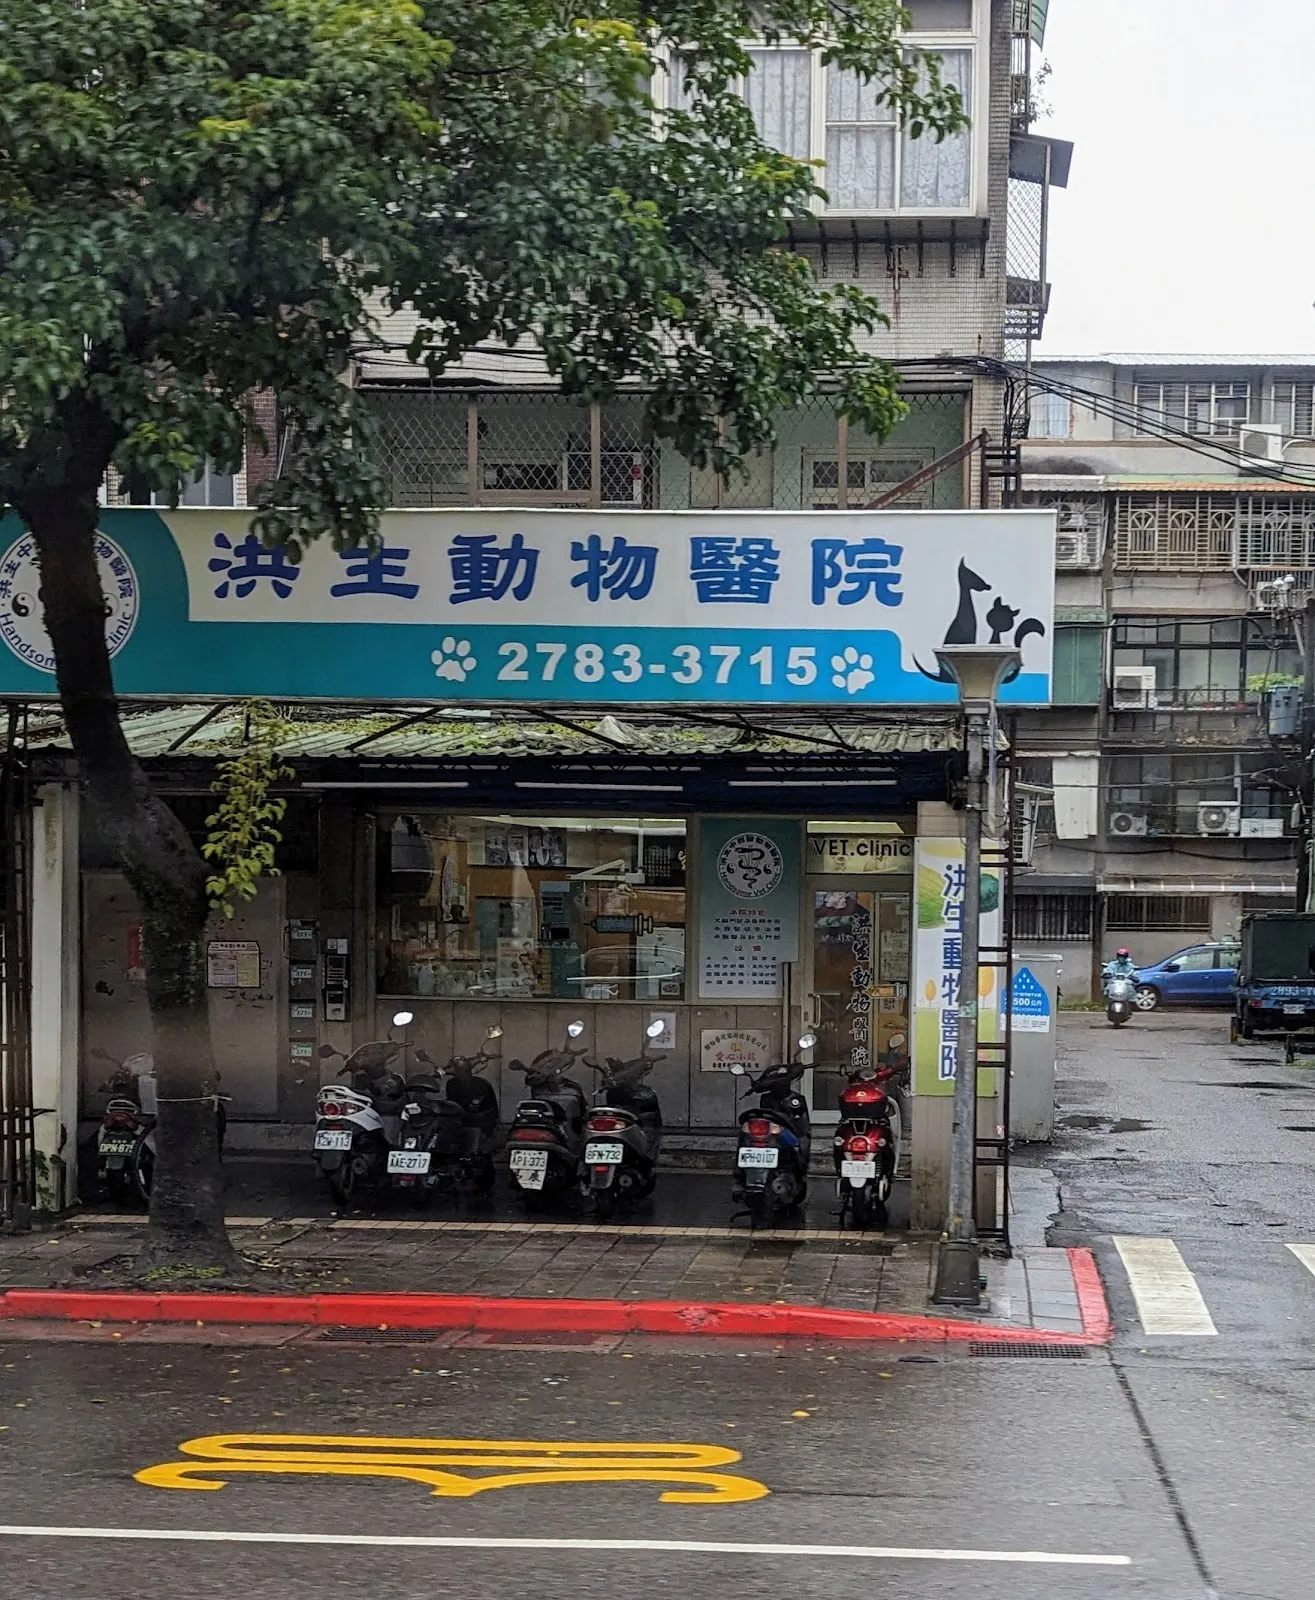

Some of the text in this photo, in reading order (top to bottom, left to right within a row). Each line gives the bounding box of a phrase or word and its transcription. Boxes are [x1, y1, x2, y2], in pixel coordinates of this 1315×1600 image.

[208, 532, 904, 607] 洪生動物醫院
[497, 641, 818, 686] 2783-3715
[813, 838, 912, 858] VET.clinic
